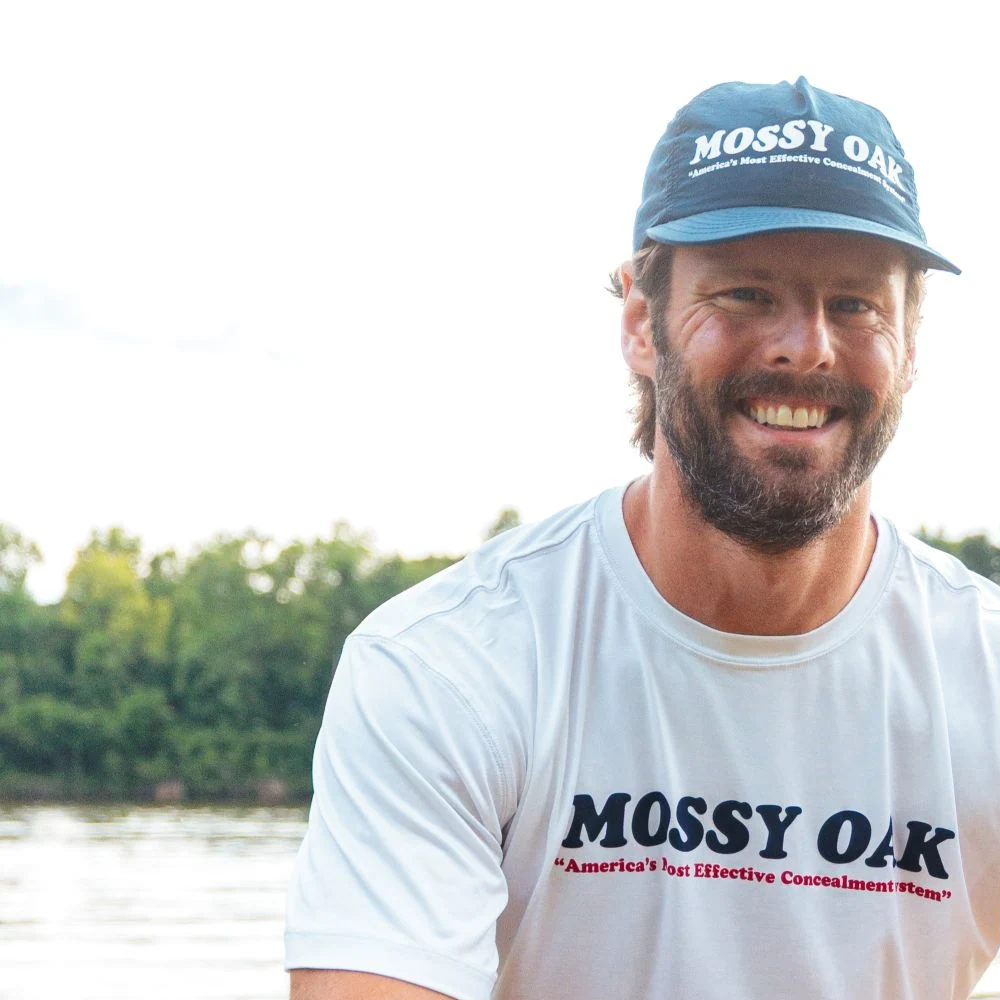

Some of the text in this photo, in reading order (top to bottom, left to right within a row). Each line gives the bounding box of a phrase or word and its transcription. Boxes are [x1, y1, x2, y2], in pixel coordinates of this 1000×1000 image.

[689, 120, 834, 165] MOSSY
[843, 135, 908, 192] OAK
[740, 155, 767, 166] Most
[769, 154, 820, 165] Effective
[561, 791, 802, 860] MOSSY
[554, 857, 657, 873] “America’s
[694, 863, 775, 884] Effective
[780, 870, 894, 892] Concealment
[895, 881, 952, 901] stem”
